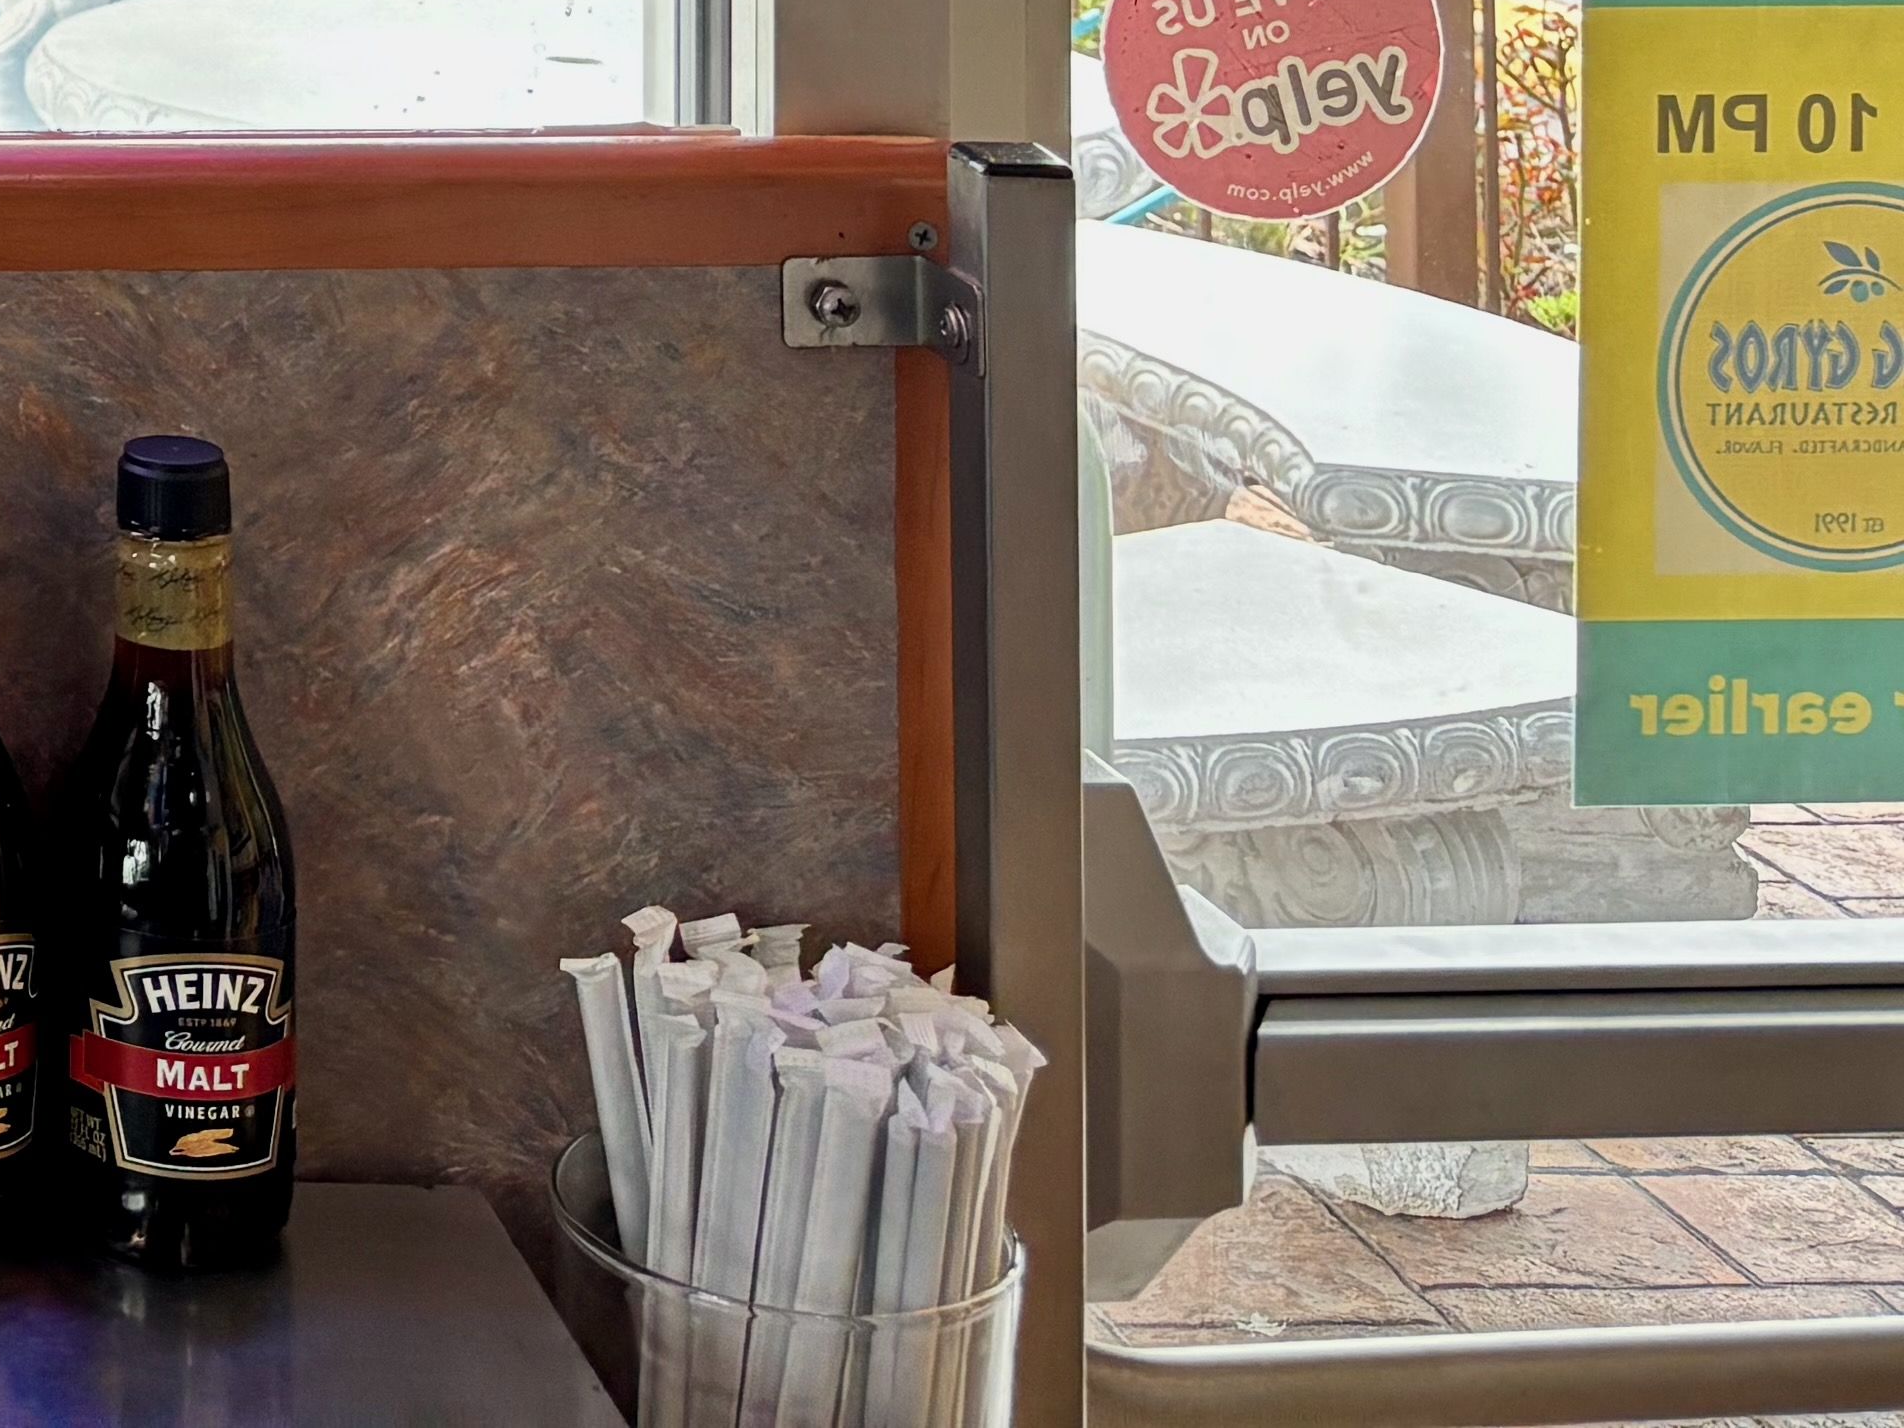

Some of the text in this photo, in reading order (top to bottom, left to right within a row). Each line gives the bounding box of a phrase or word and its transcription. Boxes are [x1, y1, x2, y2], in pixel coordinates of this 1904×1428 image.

[142, 972, 265, 1014] HEINZ
[155, 1057, 250, 1092] MALT
[165, 1103, 241, 1121] VINEGAR
